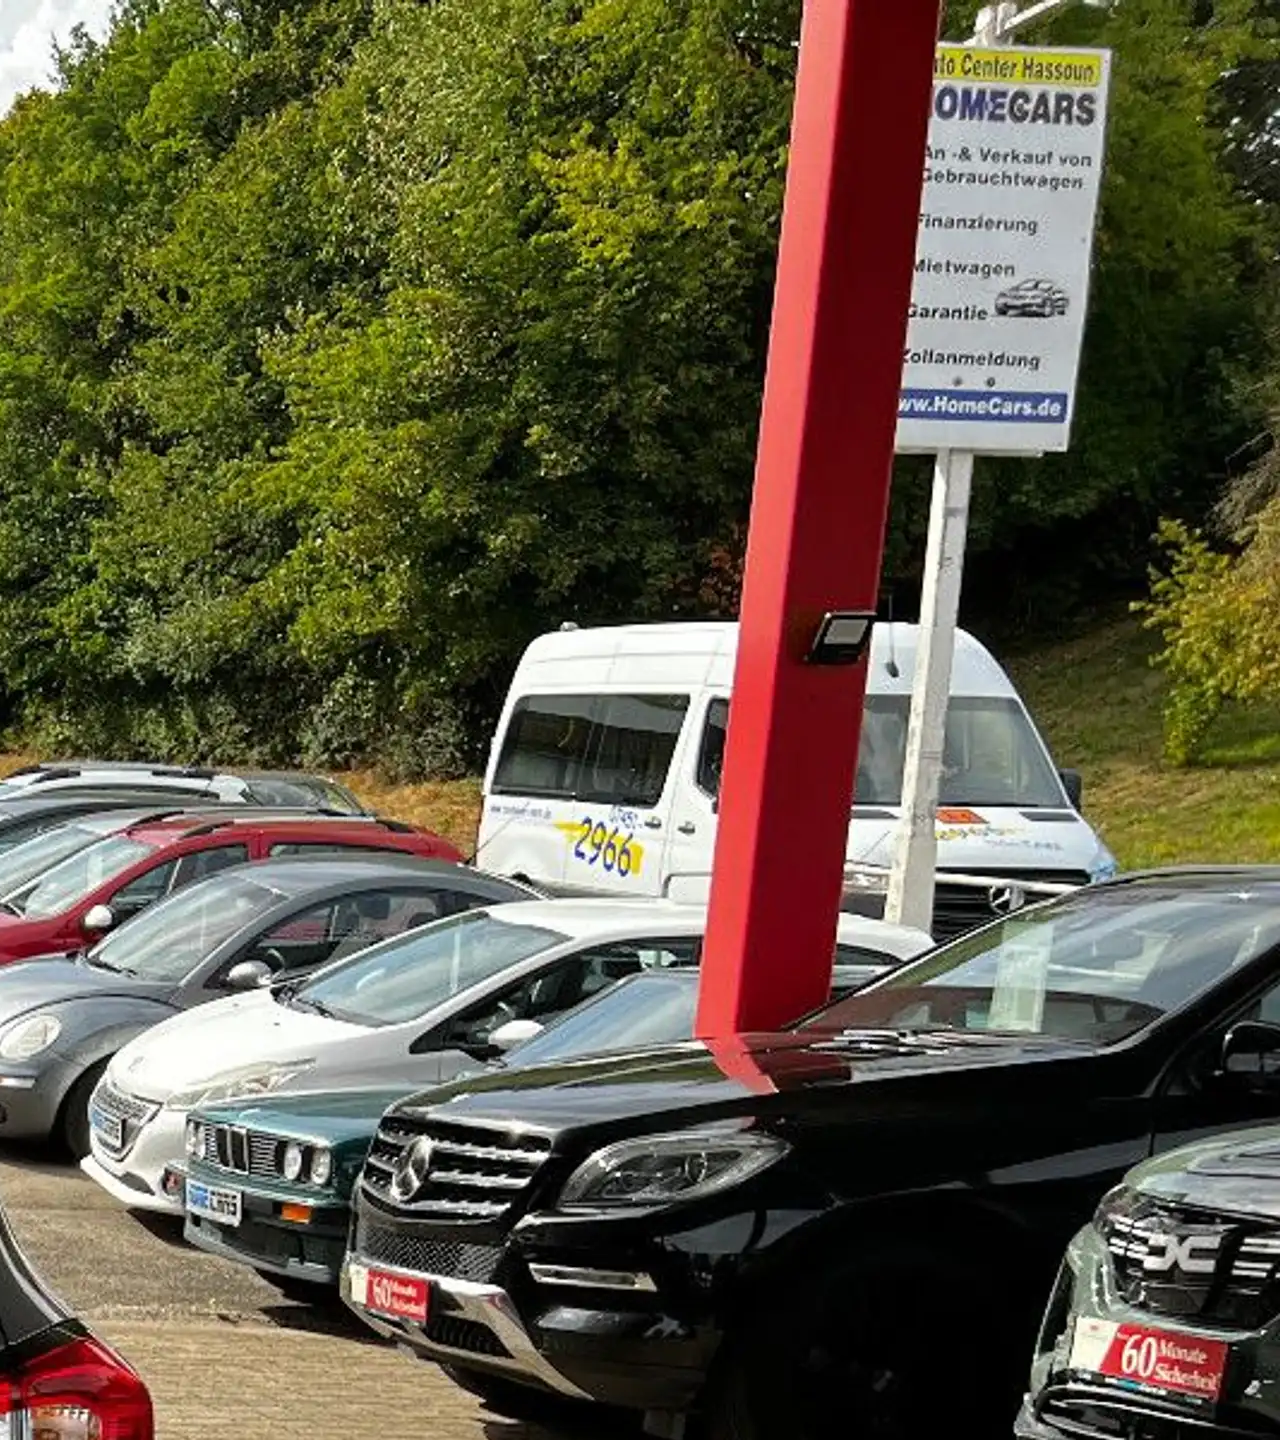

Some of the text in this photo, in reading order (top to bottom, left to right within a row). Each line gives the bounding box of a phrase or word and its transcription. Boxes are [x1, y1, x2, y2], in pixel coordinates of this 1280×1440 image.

[961, 53, 1018, 79] Center
[1022, 57, 1095, 82] Hassoun
[935, 86, 1096, 126] OMECARS
[980, 147, 1053, 166] Verkauf
[1059, 154, 1092, 167] von
[574, 815, 634, 877] 2966
[1121, 1334, 1158, 1379] 60
